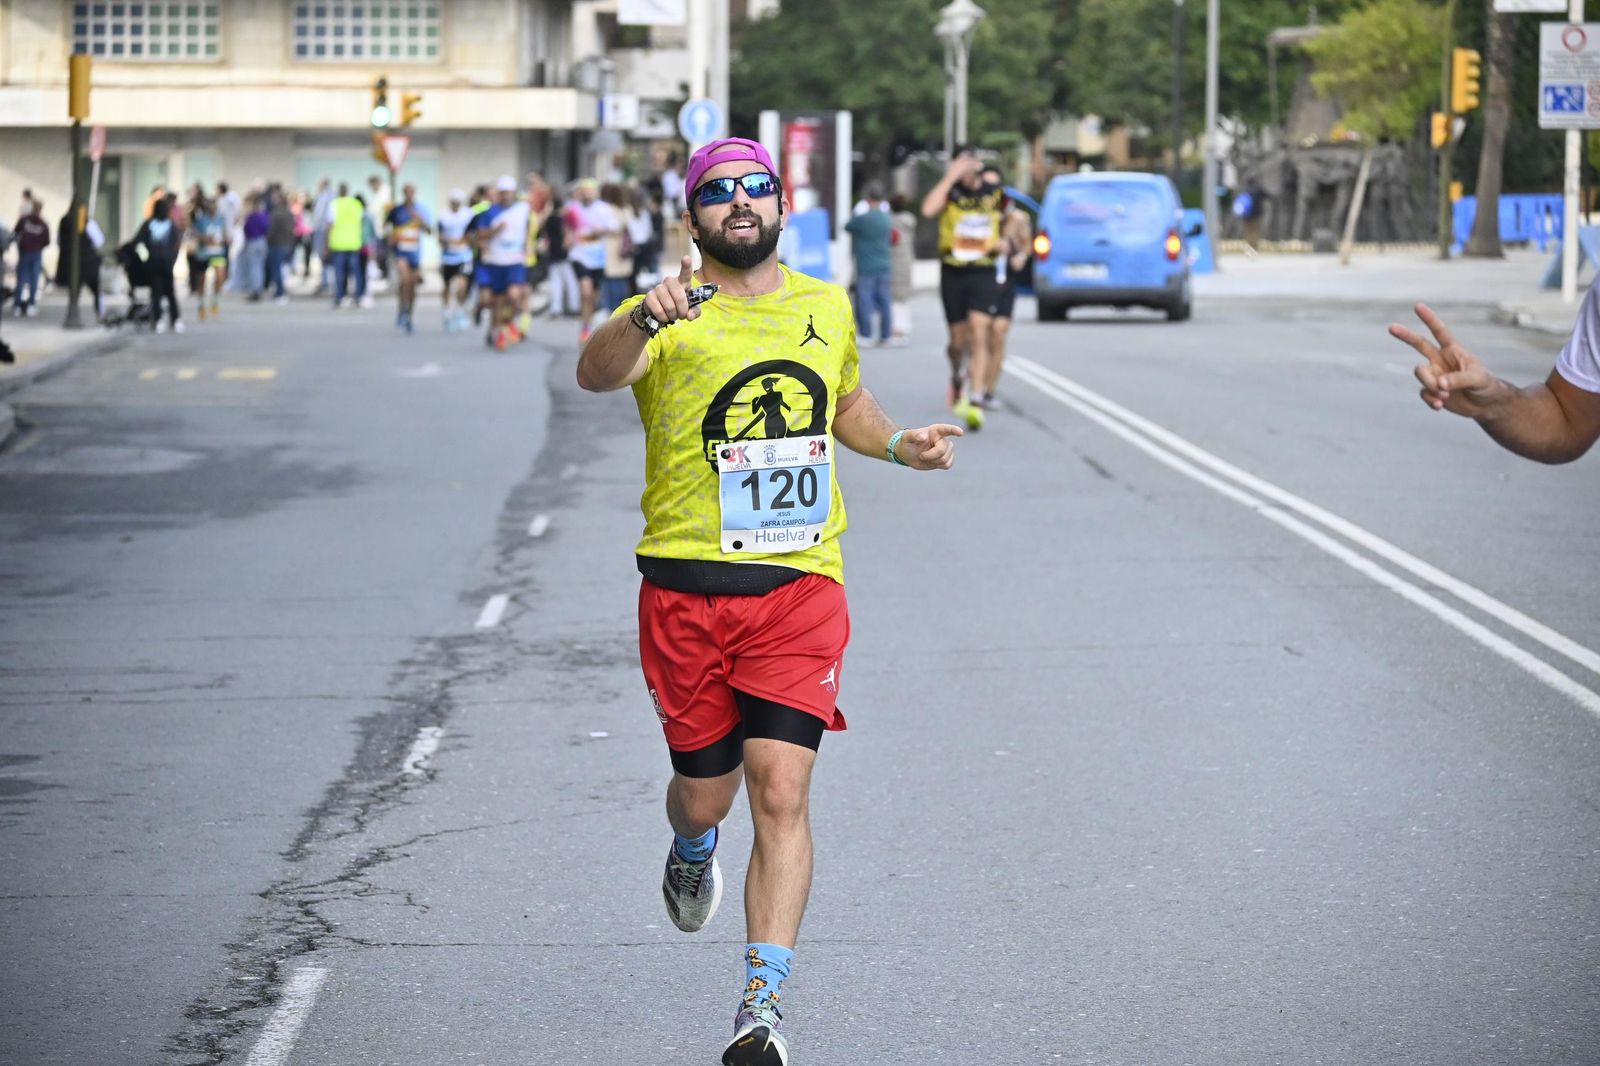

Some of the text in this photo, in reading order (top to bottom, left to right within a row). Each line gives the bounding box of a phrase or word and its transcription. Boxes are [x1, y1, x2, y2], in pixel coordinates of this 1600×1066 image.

[726, 462, 752, 471] HUELVA
[741, 467, 818, 511] 120
[760, 518, 806, 528] ZAFRA CAMPOS
[755, 528, 806, 544] Huelva
